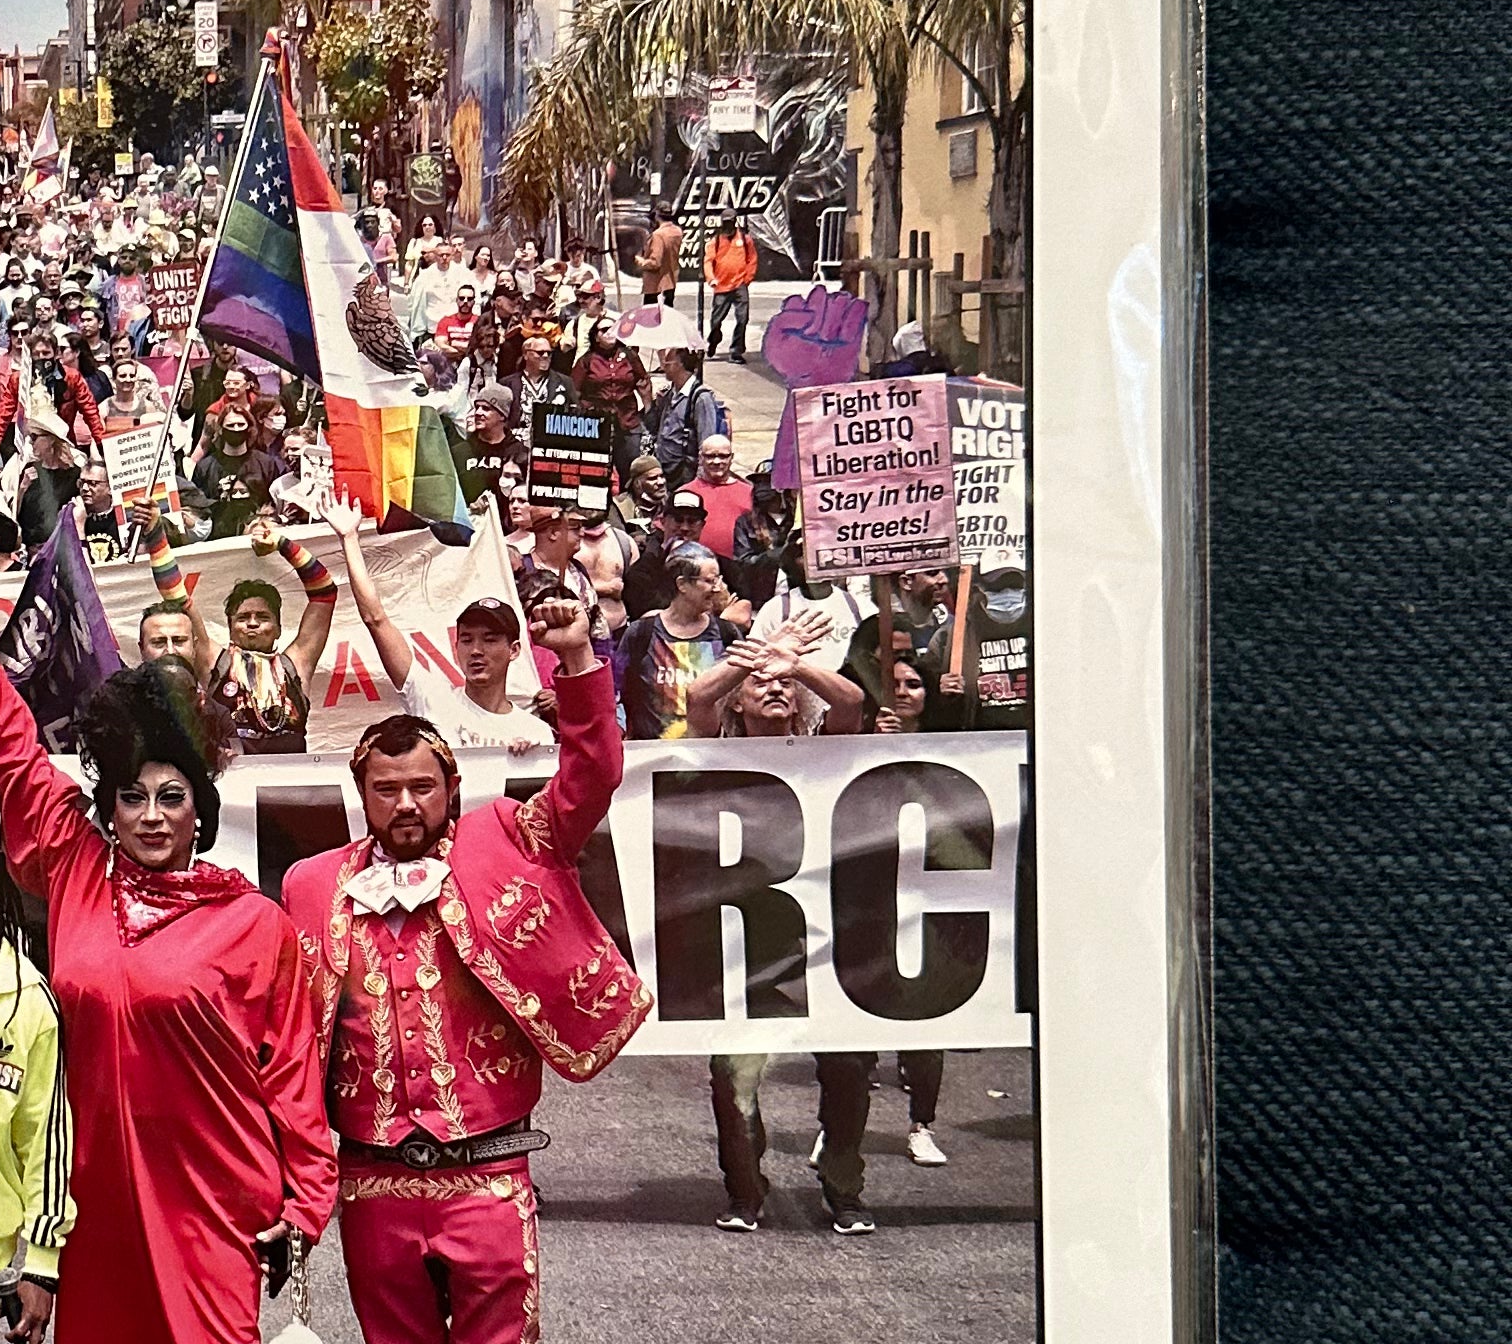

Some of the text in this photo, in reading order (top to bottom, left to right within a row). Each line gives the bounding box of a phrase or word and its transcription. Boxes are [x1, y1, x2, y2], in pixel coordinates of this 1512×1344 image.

[198, 17, 214, 28] 20
[713, 105, 752, 114] ANY TIME
[705, 151, 766, 171] LOVE
[822, 386, 921, 418] Fight for
[545, 414, 599, 439] HANCOCK
[834, 416, 914, 446] LGBTQ
[117, 436, 136, 445] OPEN
[812, 442, 939, 477] Liberation!
[819, 479, 944, 513] Stay in the
[957, 486, 1000, 506] FOR
[837, 510, 930, 542] streets!
[957, 515, 1008, 534] GBTQ
[818, 546, 861, 567] PSL
[981, 640, 1008, 657] TAND
